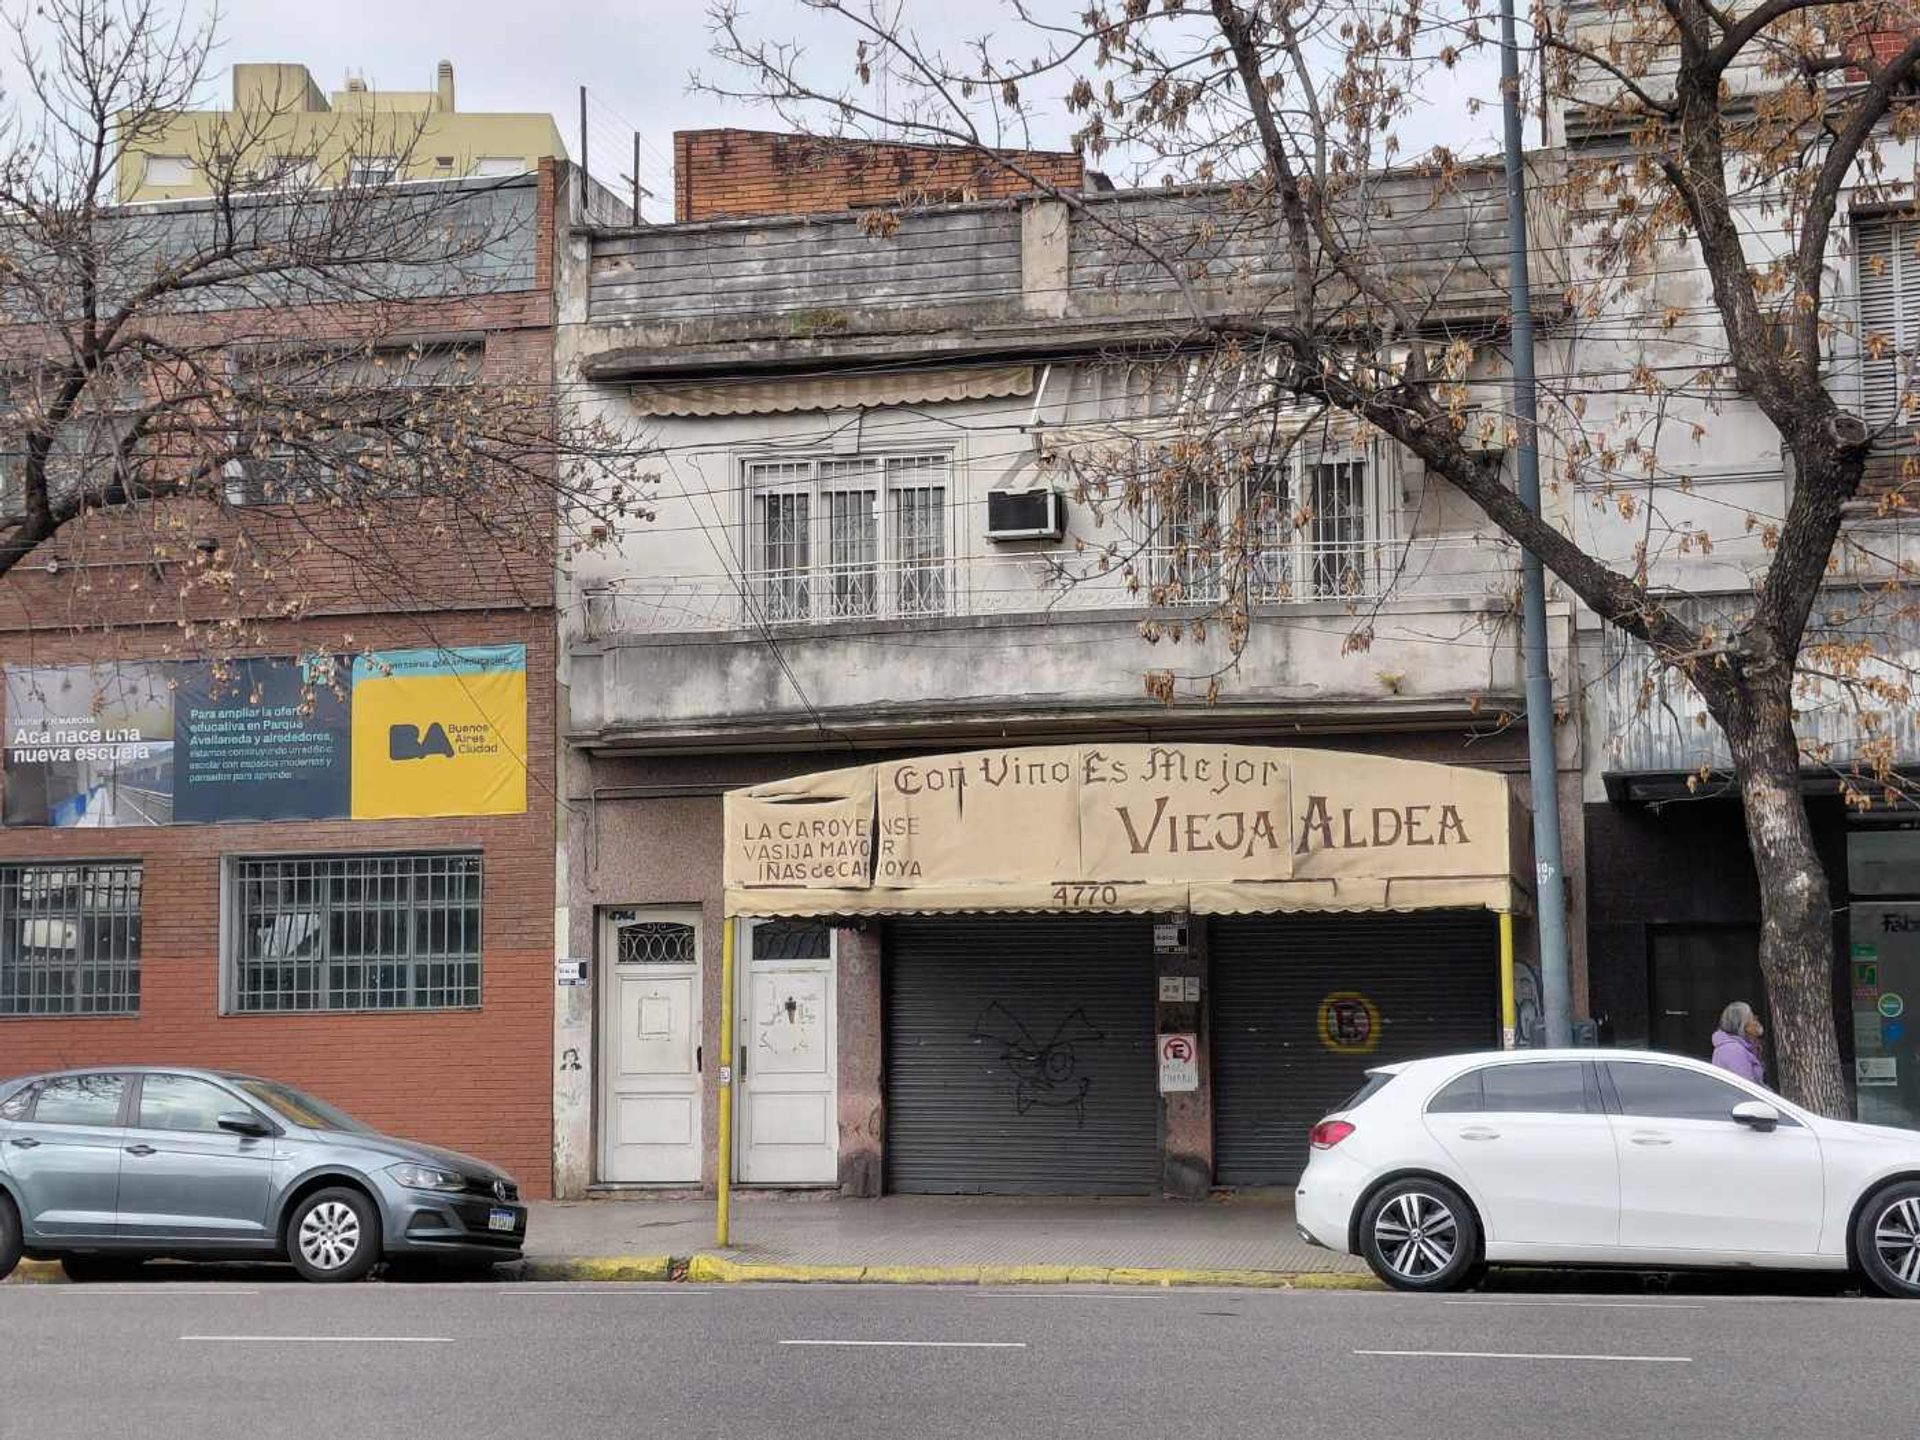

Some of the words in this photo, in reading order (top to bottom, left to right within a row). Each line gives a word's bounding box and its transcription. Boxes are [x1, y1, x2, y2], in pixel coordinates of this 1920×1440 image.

[190, 708, 216, 719] Para
[218, 706, 259, 720] ampliar
[261, 706, 272, 717] la
[274, 705, 306, 717] ofert
[190, 721, 244, 732] educativa
[247, 722, 260, 731] en
[263, 720, 303, 731] Parque
[449, 724, 489, 734] Buenos
[56, 729, 101, 743] nace
[106, 727, 142, 742] una
[190, 735, 252, 746] Avellaneda
[254, 735, 260, 745] y
[456, 733, 485, 743] Aires
[14, 748, 71, 763] nueva
[75, 743, 150, 761] escuela
[459, 743, 498, 754] Ciudad
[894, 764, 967, 795] Con
[980, 755, 1070, 786] Vino
[1083, 750, 1128, 785] Es
[1141, 748, 1278, 795] Mejor
[744, 822, 772, 840] LA
[778, 817, 920, 840] CAROYENSE
[1115, 796, 1279, 859] VIEJA
[1295, 795, 1471, 854] ALDEA
[743, 843, 813, 861] VASIJA
[820, 839, 895, 857] MAYOR
[811, 862, 835, 878] de
[1053, 886, 1117, 906] 4770
